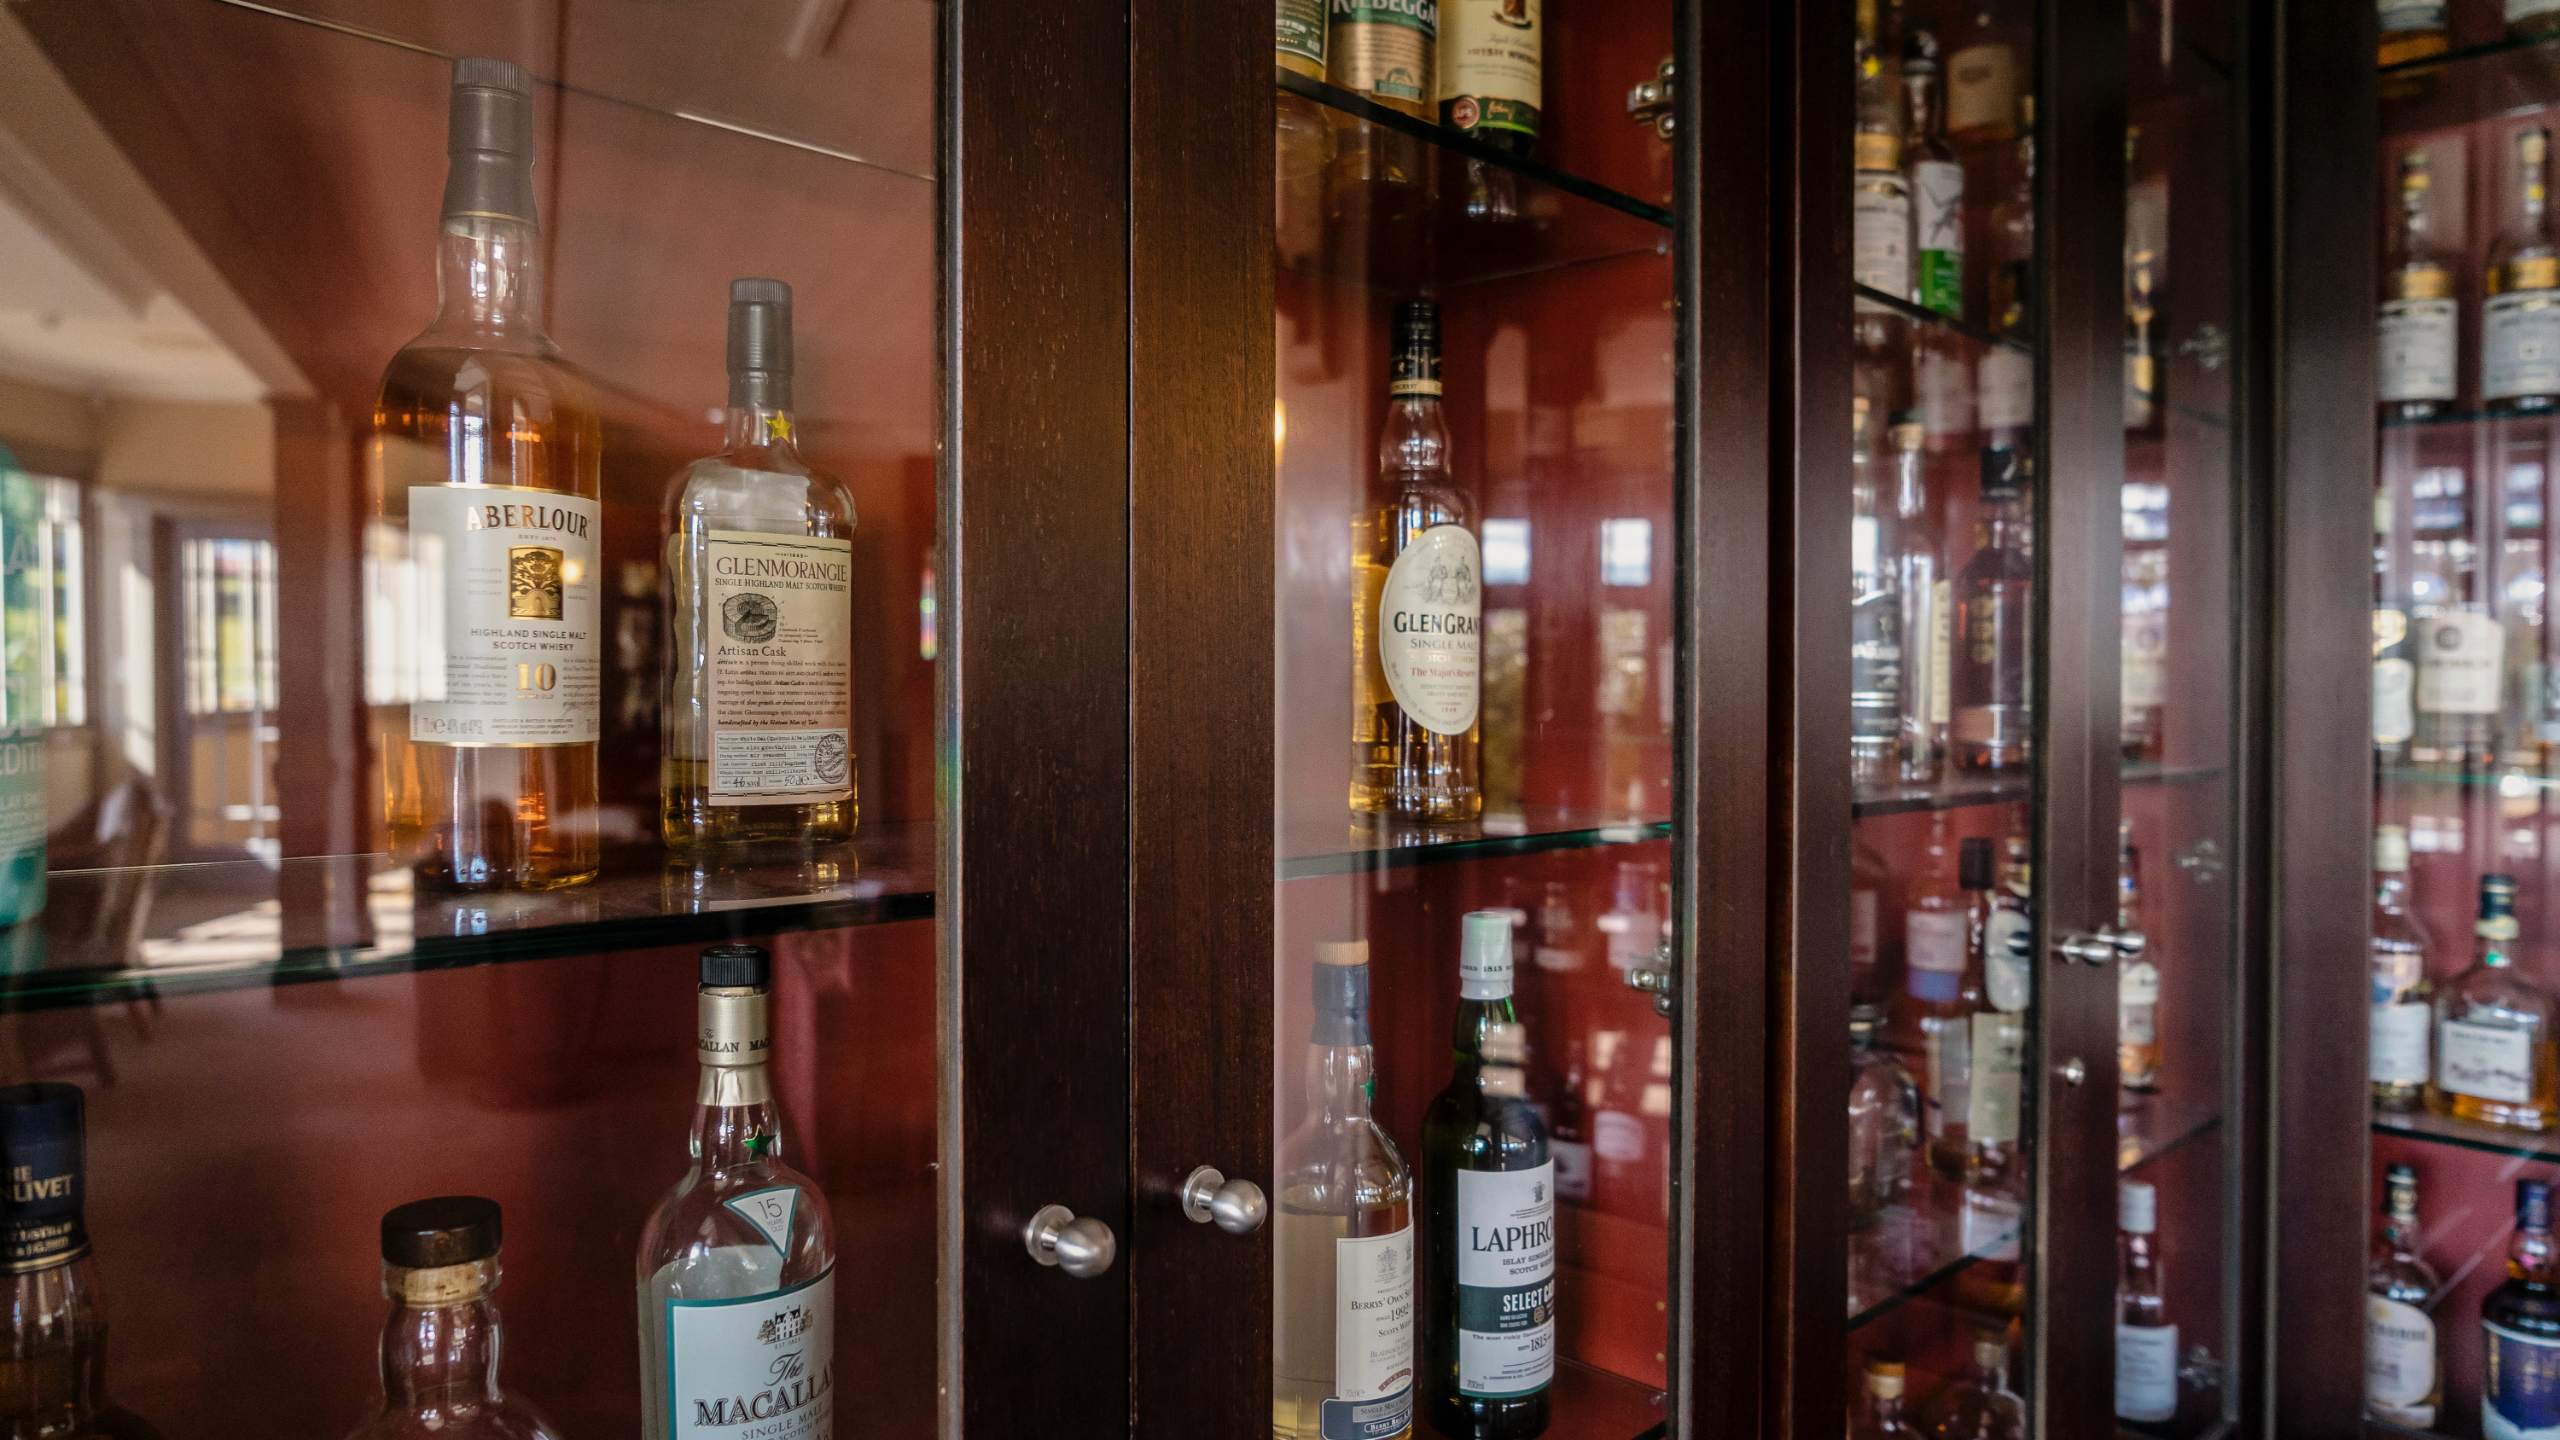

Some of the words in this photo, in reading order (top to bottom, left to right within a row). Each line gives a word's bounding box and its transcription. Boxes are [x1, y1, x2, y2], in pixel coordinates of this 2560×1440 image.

[466, 504, 588, 540] ABERLOUR
[716, 556, 848, 582] GLENMORANGIE
[714, 577, 742, 587] SINGLE
[744, 578, 784, 589] HIGHLAND
[785, 581, 804, 590] MALT
[805, 582, 828, 592] SCOTCH
[828, 583, 847, 593] WHISKY
[470, 627, 529, 638] HIGHLAND
[532, 629, 567, 640] SINGLE
[569, 631, 588, 640] MALT
[1410, 638, 1454, 649] SINGLE
[493, 641, 537, 651] SCOTCH
[540, 643, 575, 651] WHISKY
[717, 645, 759, 656] Artisan
[761, 645, 787, 657] Cask
[514, 662, 557, 693] 10
[1410, 666, 1427, 677] The
[699, 1039, 740, 1053] CALLAN
[14, 1173, 74, 1203] LIVET
[757, 1197, 783, 1220] 15
[1471, 1215, 1552, 1252] LAPHRO
[1502, 1256, 1527, 1266] ISLAY
[1509, 1263, 1538, 1276] SCOTCH
[1503, 1288, 1543, 1313] SELECT
[763, 1348, 805, 1387] The
[694, 1361, 834, 1428] MACALLA
[742, 1418, 793, 1440] SINGLE
[799, 1402, 823, 1422] MALT
